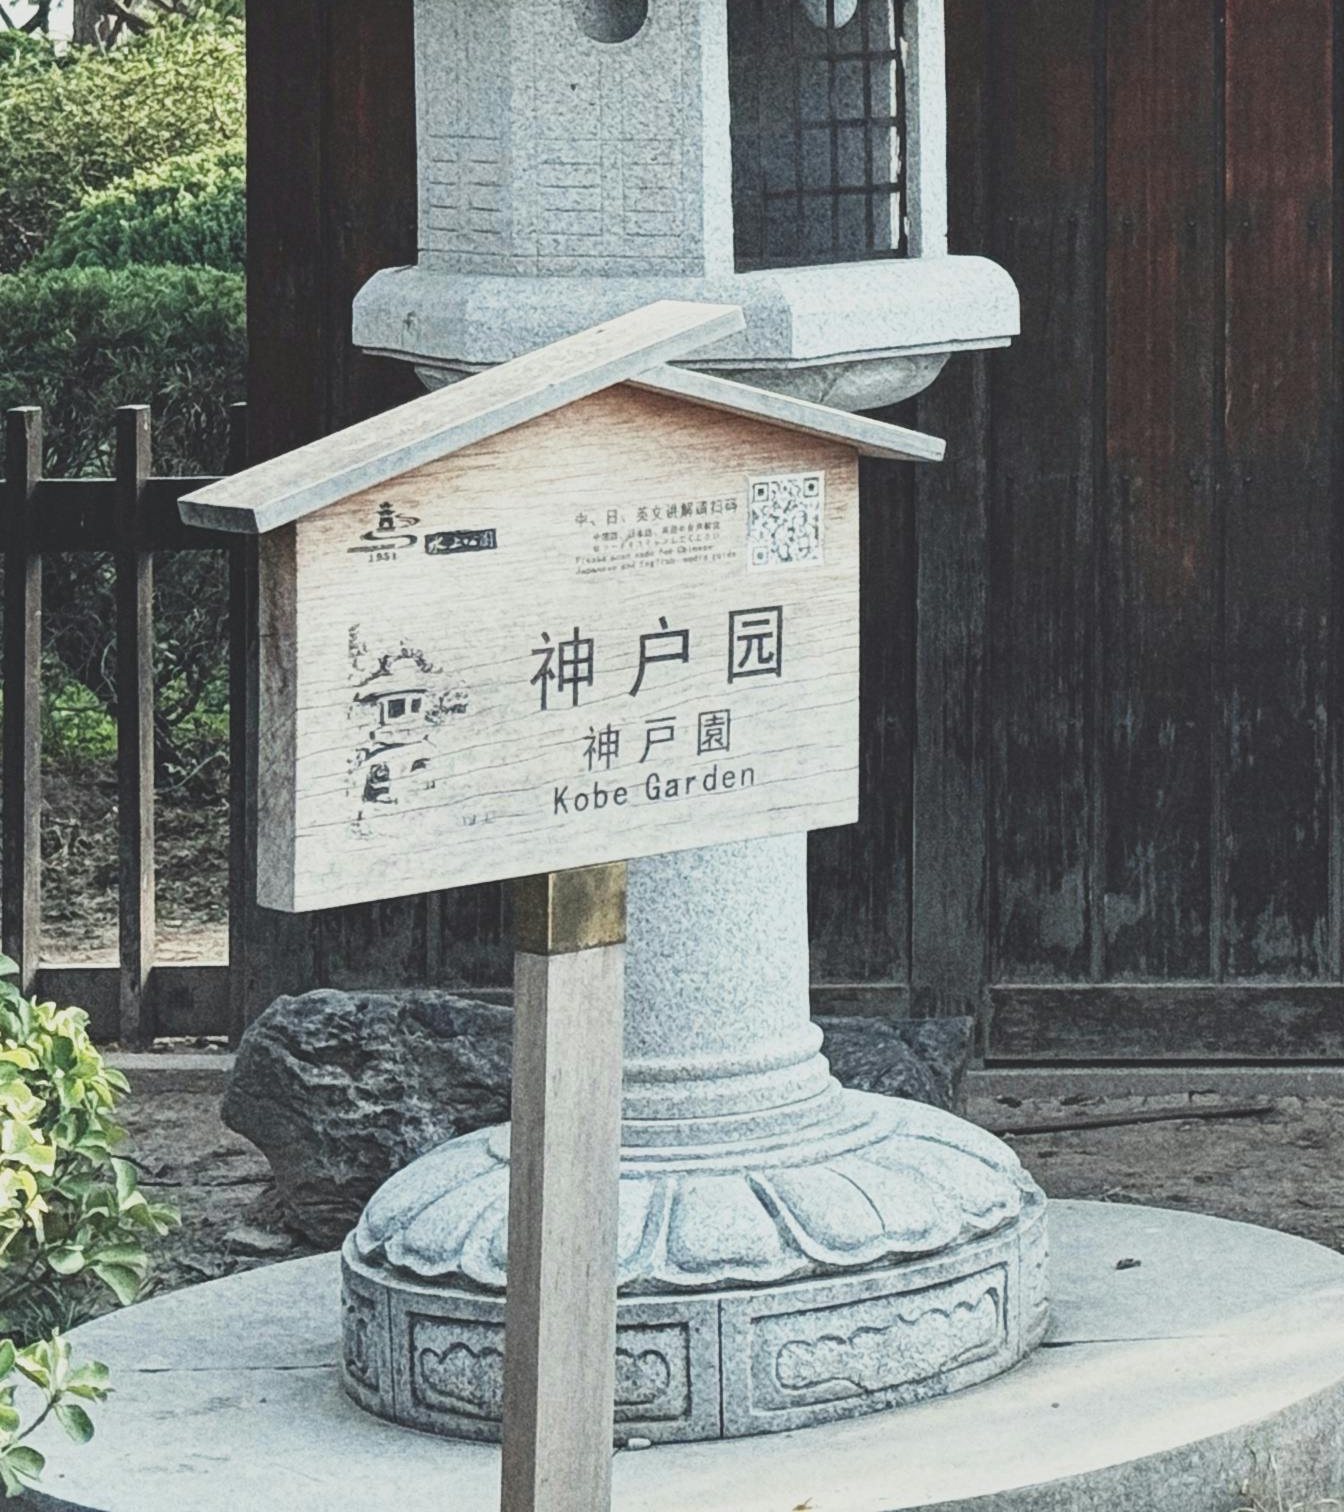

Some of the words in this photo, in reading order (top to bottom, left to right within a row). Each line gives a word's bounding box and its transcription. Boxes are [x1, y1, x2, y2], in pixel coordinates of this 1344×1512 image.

[530, 604, 783, 711] 神户园
[582, 708, 731, 772] 神戸園
[553, 781, 628, 815] Kobe
[645, 763, 755, 801] Garden
